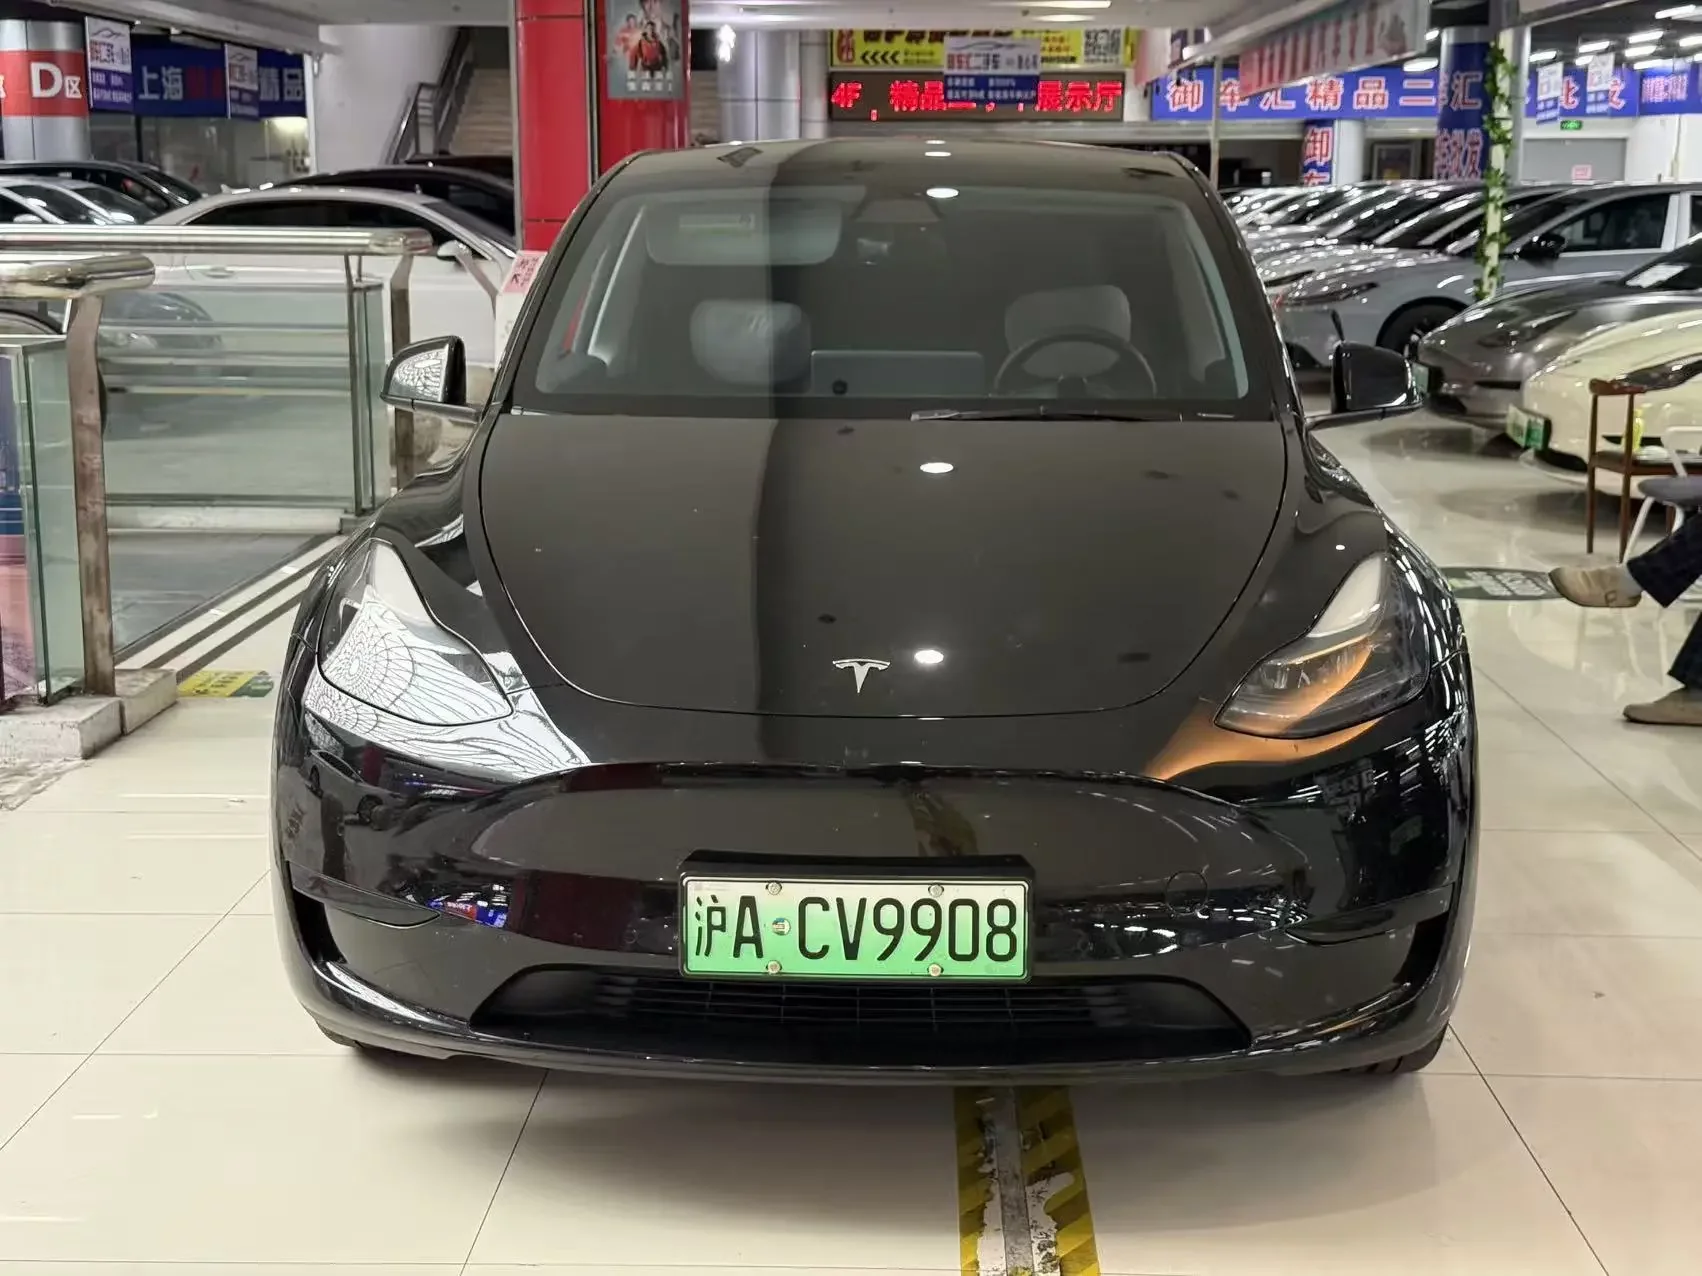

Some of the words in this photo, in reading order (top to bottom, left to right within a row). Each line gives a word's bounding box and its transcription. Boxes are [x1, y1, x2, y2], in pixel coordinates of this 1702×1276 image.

[31, 62, 82, 99] D区
[695, 894, 764, 959] 沪A
[798, 896, 1018, 963] CV9908
